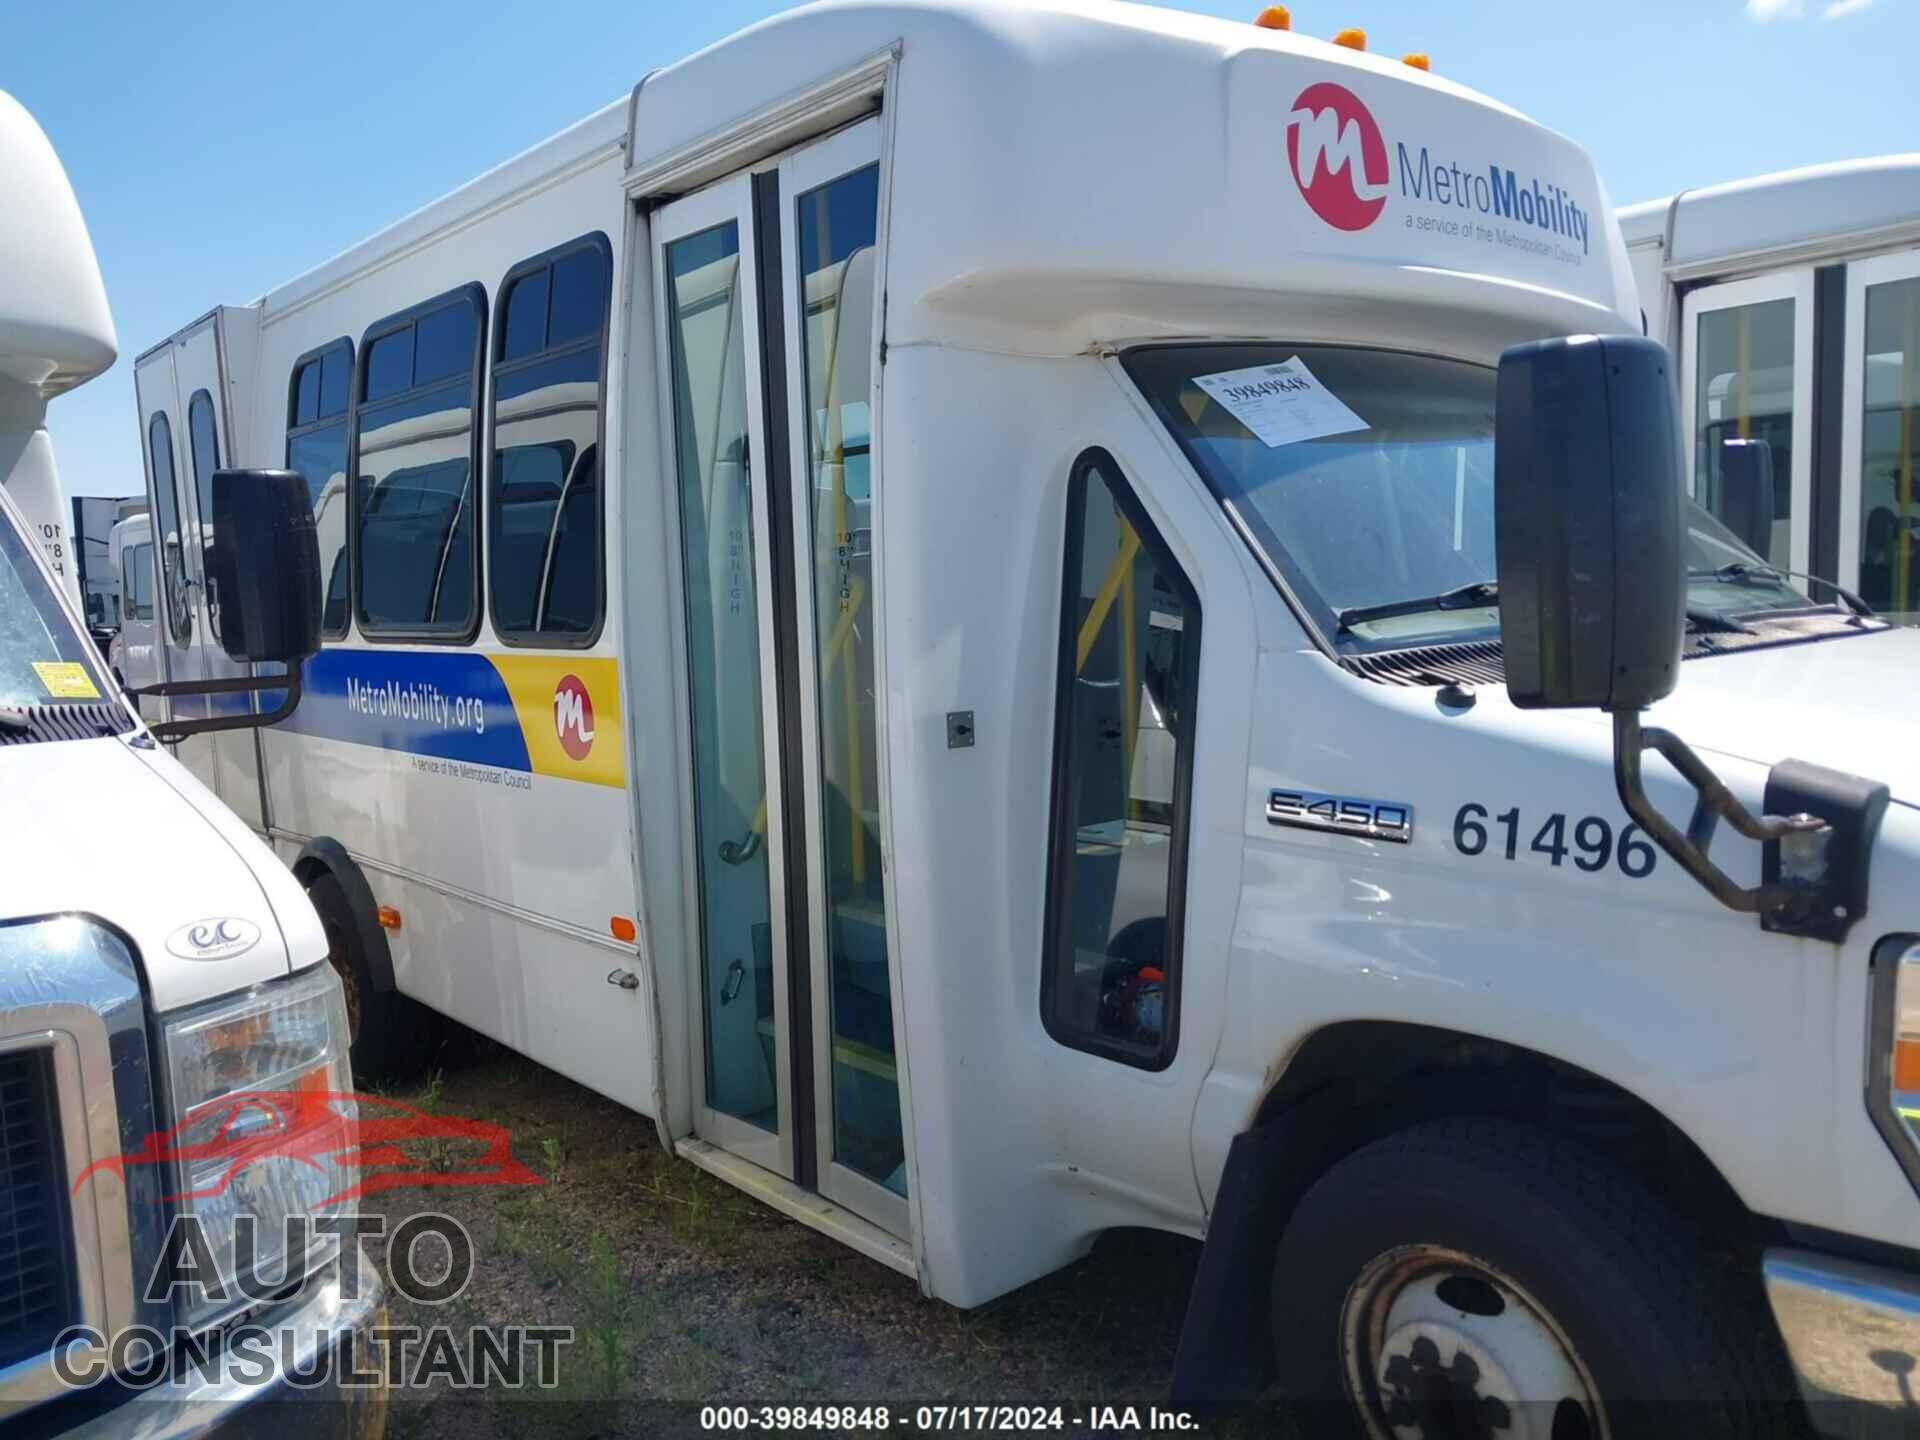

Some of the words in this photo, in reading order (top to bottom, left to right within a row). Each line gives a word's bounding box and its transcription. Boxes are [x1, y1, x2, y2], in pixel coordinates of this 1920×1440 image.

[1397, 141, 1588, 255] MetroMobility
[1405, 213, 1414, 228] a
[1416, 214, 1460, 237] service
[1462, 221, 1474, 238] of
[1475, 225, 1494, 243] the
[1222, 376, 1312, 401] 39849848
[347, 676, 485, 735] MetroMobility.org
[416, 759, 440, 774] service
[440, 761, 448, 775] of
[448, 762, 459, 777] the
[460, 763, 502, 784] Metropolitan
[504, 770, 532, 789] Council
[1453, 802, 1658, 879] 61496
